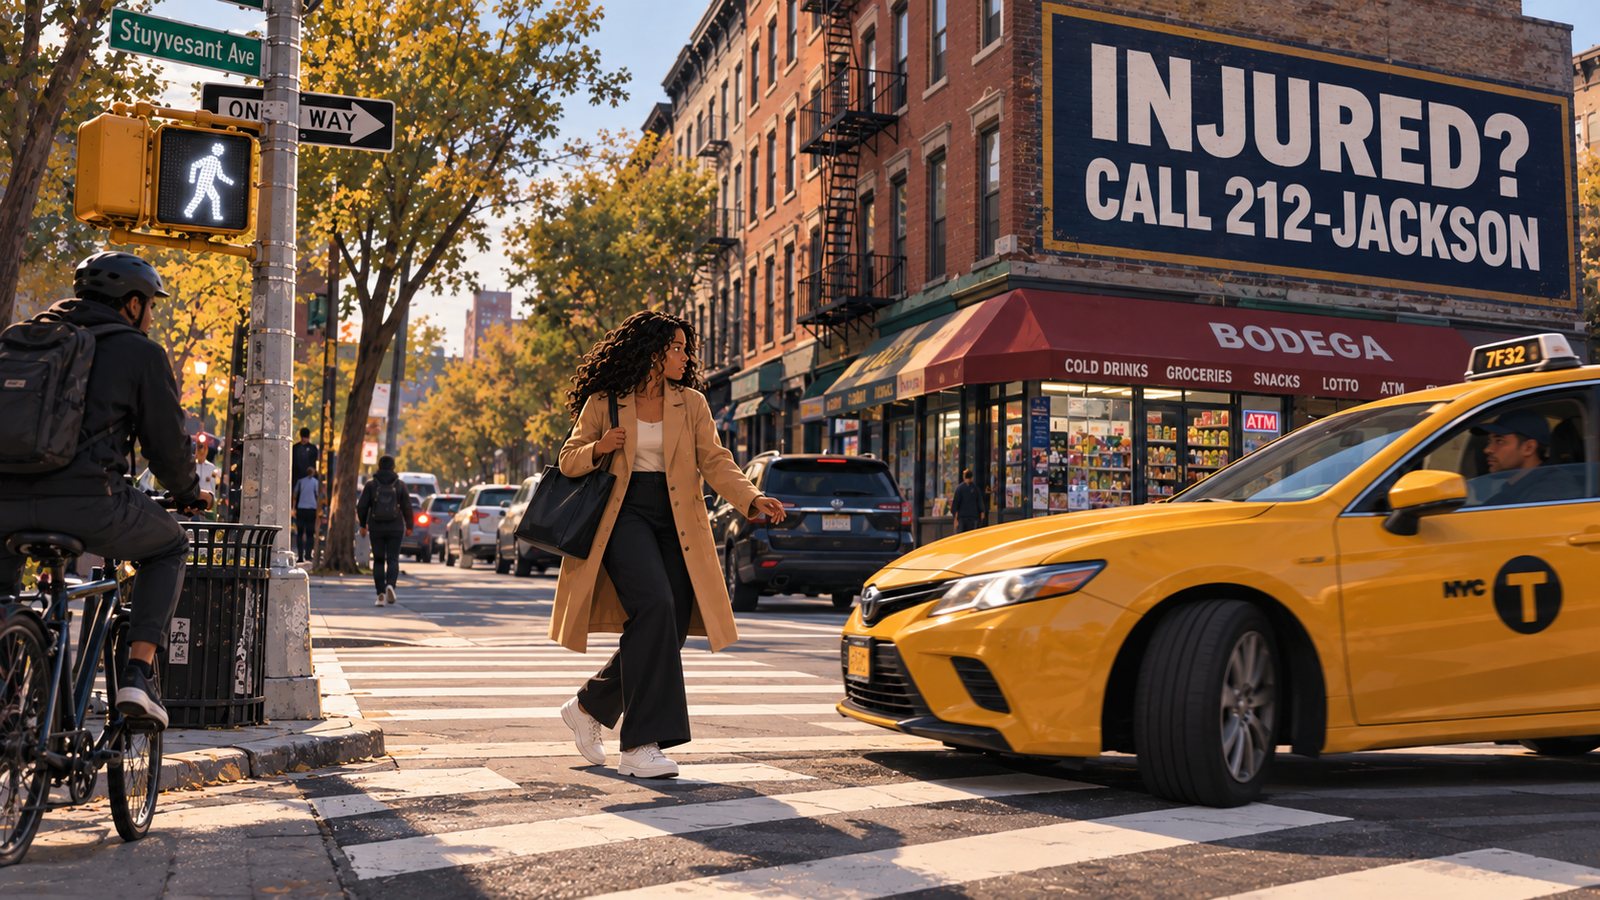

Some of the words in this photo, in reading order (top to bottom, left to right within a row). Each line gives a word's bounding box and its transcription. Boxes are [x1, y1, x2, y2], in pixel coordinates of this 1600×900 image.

[120, 18, 223, 61] Stuyvesant
[228, 42, 255, 66] Ave
[229, 100, 264, 120] ON
[309, 109, 357, 131] WAY
[1090, 43, 1530, 198] INJURED?
[1085, 157, 1212, 231] CALL
[1225, 176, 1541, 271] 212-JACKSON
[1208, 322, 1393, 363] BODEGA
[1485, 345, 1526, 369] 7F32
[1065, 358, 1099, 375] COLD
[1103, 361, 1148, 379] DRINKS
[1166, 365, 1232, 384] GROCERIES
[1253, 371, 1301, 389] SNACKS
[1322, 376, 1359, 393] LOTTO
[1380, 381, 1405, 395] ATM
[1245, 413, 1277, 431] ATM
[1443, 579, 1486, 598] NYC
[1506, 571, 1548, 623] T
